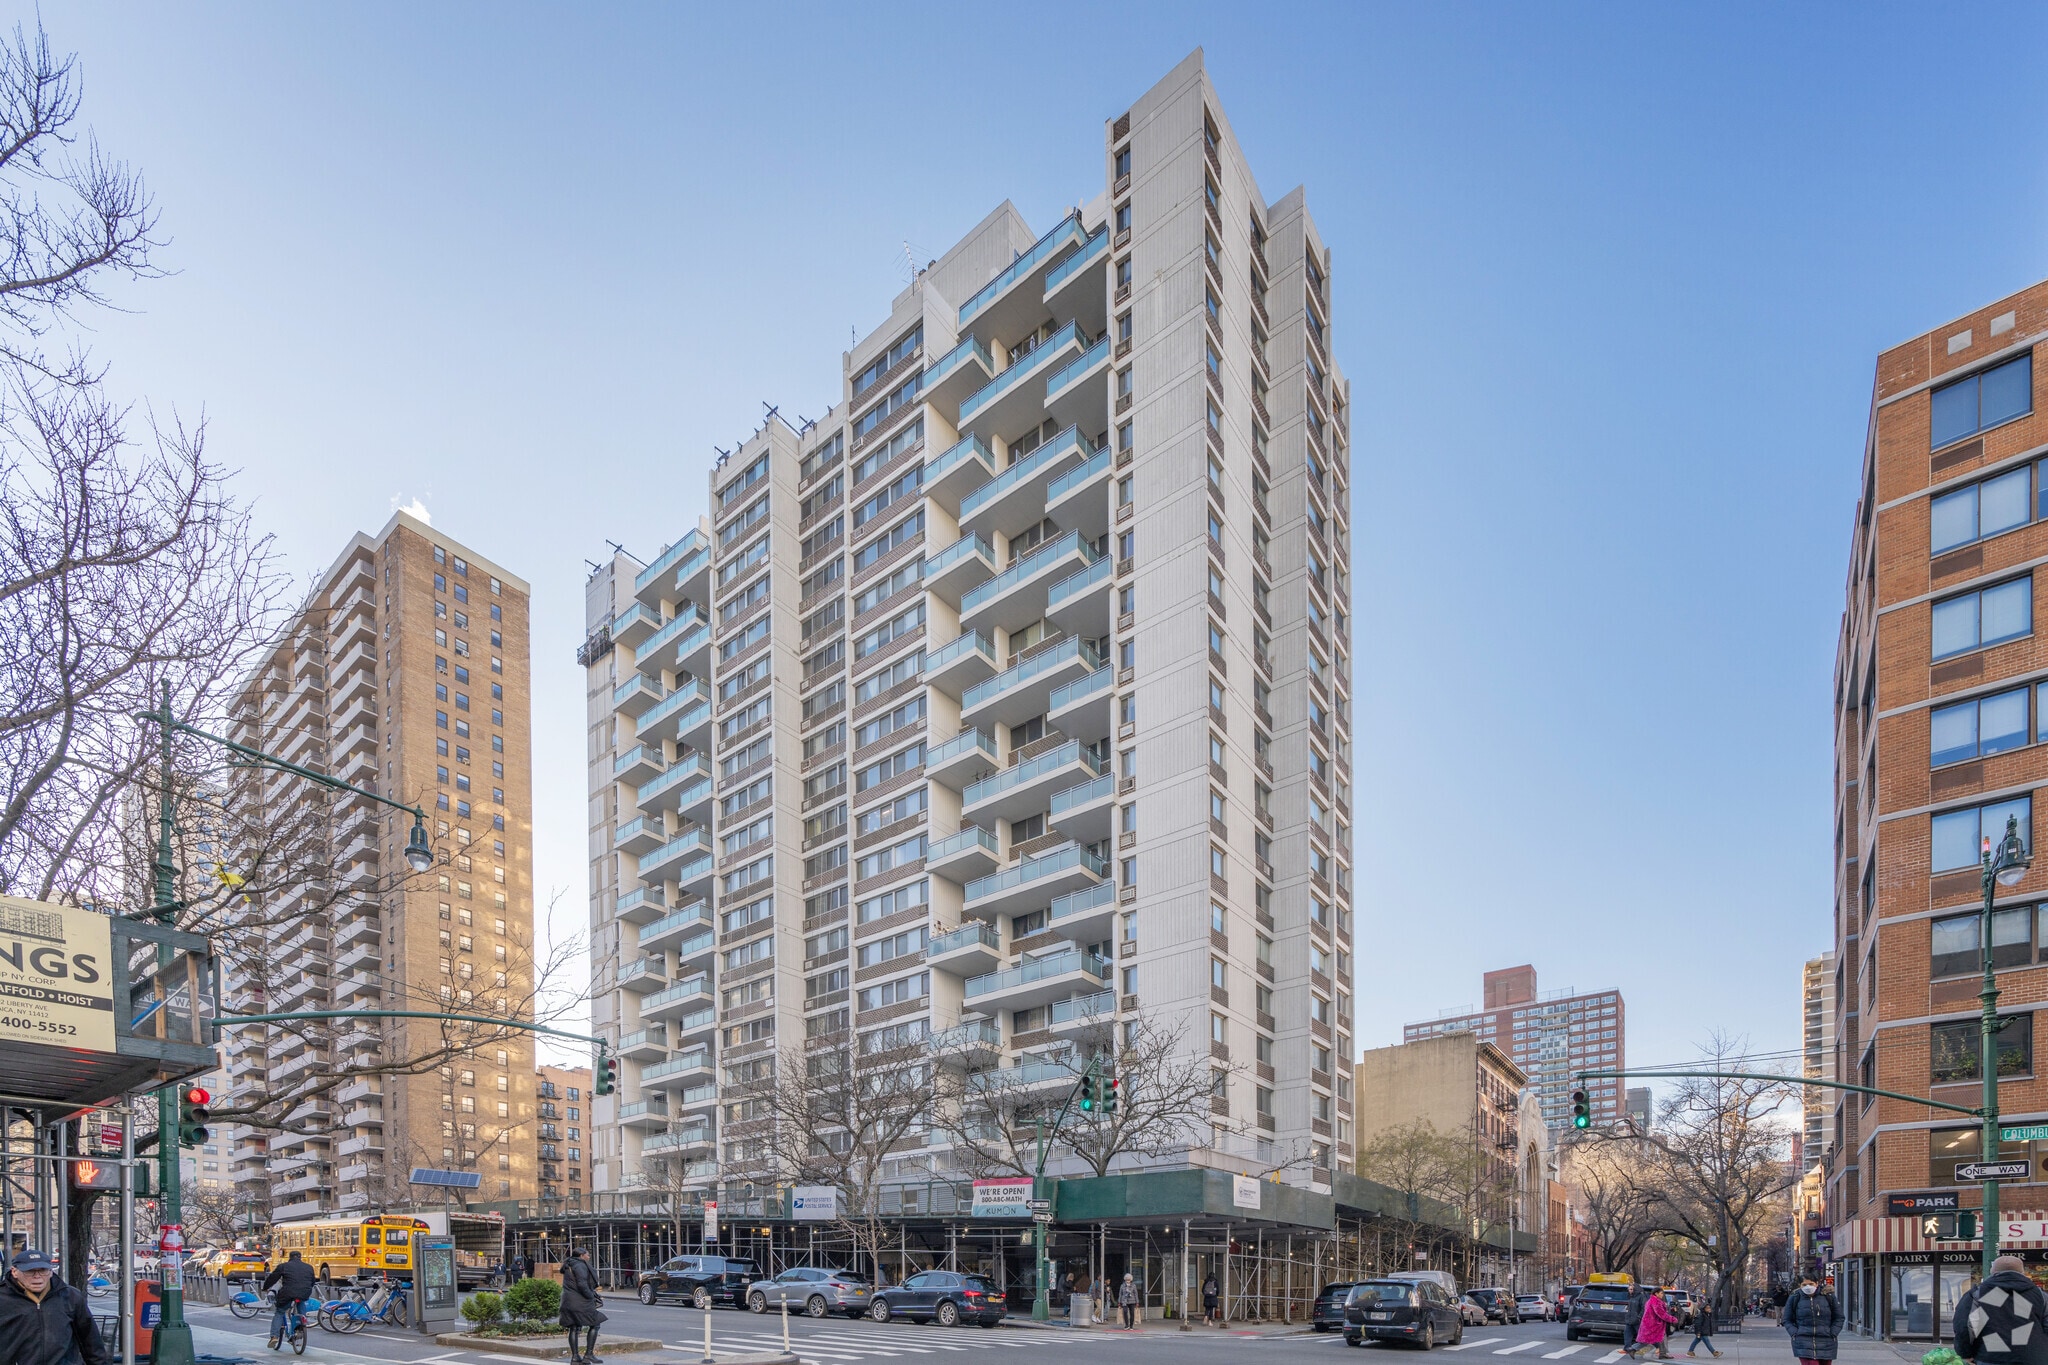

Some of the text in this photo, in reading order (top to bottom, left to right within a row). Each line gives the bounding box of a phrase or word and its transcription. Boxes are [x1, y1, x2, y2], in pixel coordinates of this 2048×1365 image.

[11, 973, 25, 981] NY
[28, 976, 57, 987] CORP.
[6, 1000, 33, 1009] LIBERTY
[57, 993, 94, 1007] HOIST
[28, 1010, 49, 1018] 11412
[0, 1016, 77, 1036] 400-5552
[1965, 1165, 2023, 1176] ONE WAY
[979, 1187, 1025, 1196] WE'RE OPEN!
[1915, 1197, 1956, 1207] PARK
[986, 1206, 1017, 1216] KUMON
[1895, 1255, 1931, 1263] DAIRY
[1943, 1254, 1975, 1262] SODA
